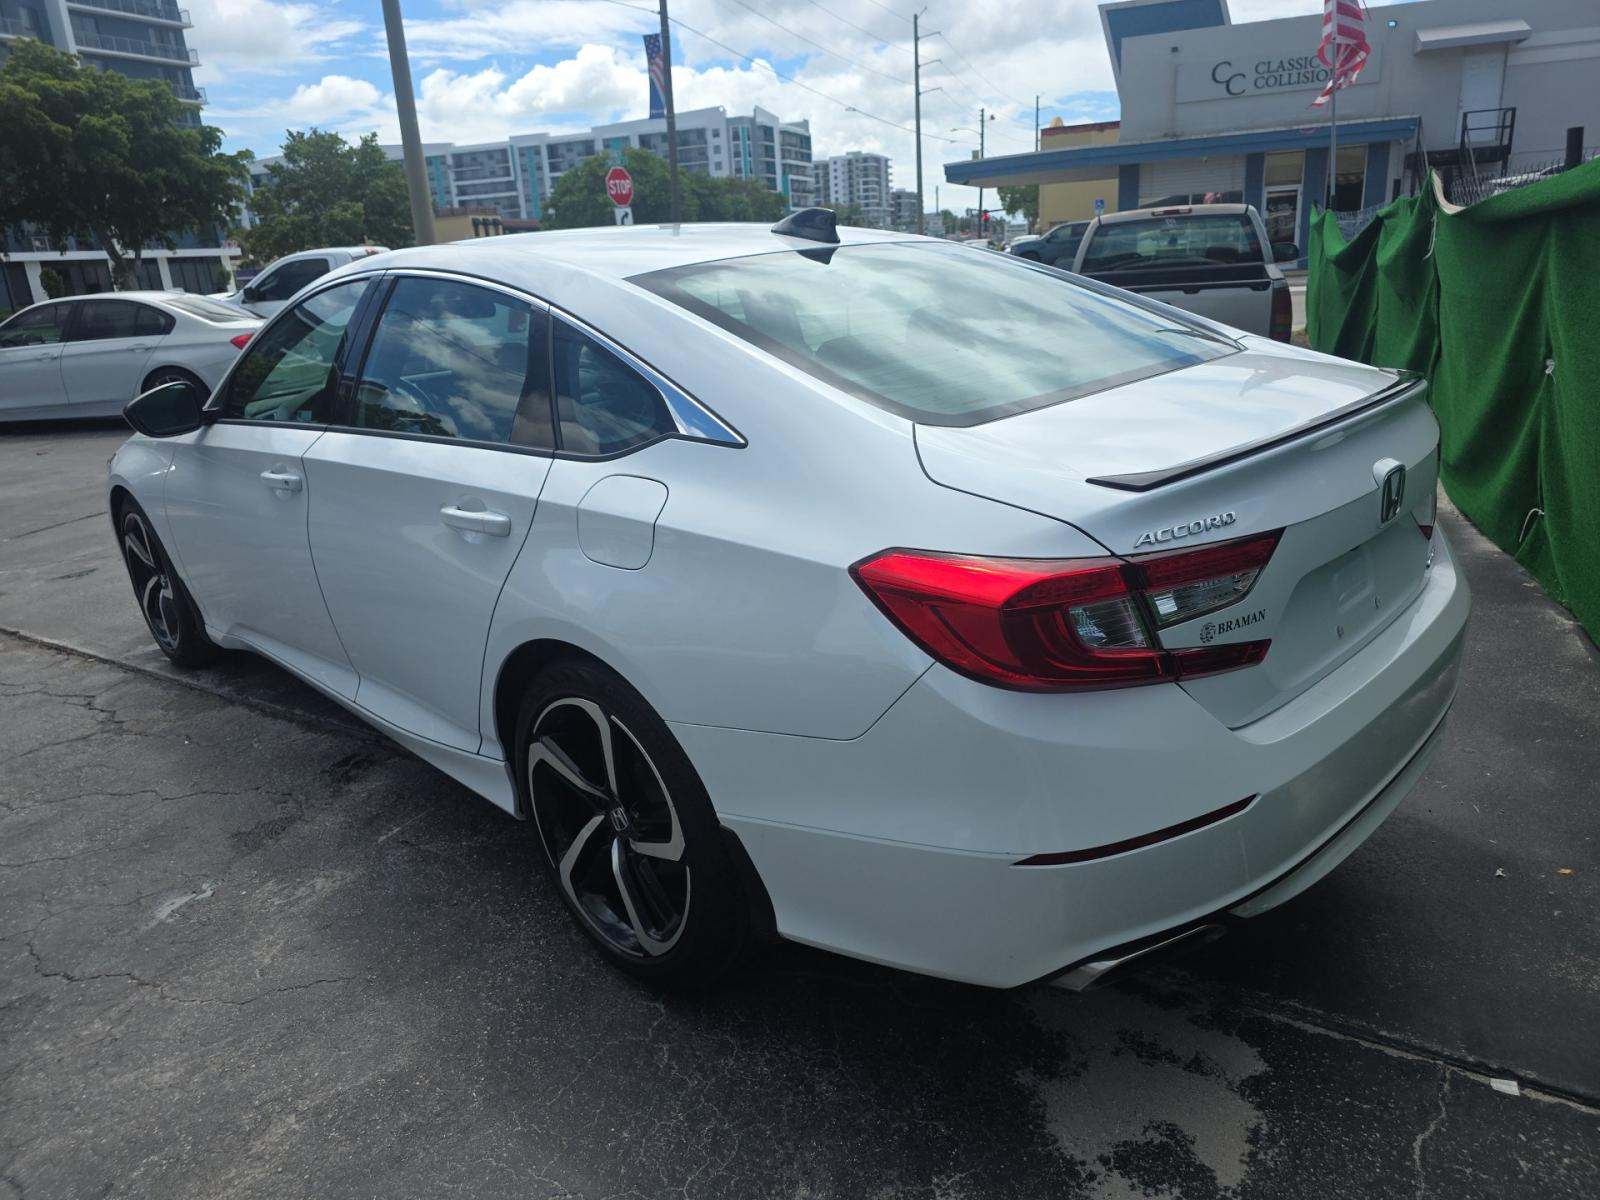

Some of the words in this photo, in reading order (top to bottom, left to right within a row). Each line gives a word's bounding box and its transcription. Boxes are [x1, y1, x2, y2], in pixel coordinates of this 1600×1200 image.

[1254, 55, 1320, 75] CLASSIC
[609, 179, 632, 195] STOP
[1134, 511, 1236, 548] ACCORD
[1218, 608, 1266, 635] BRAMAN
